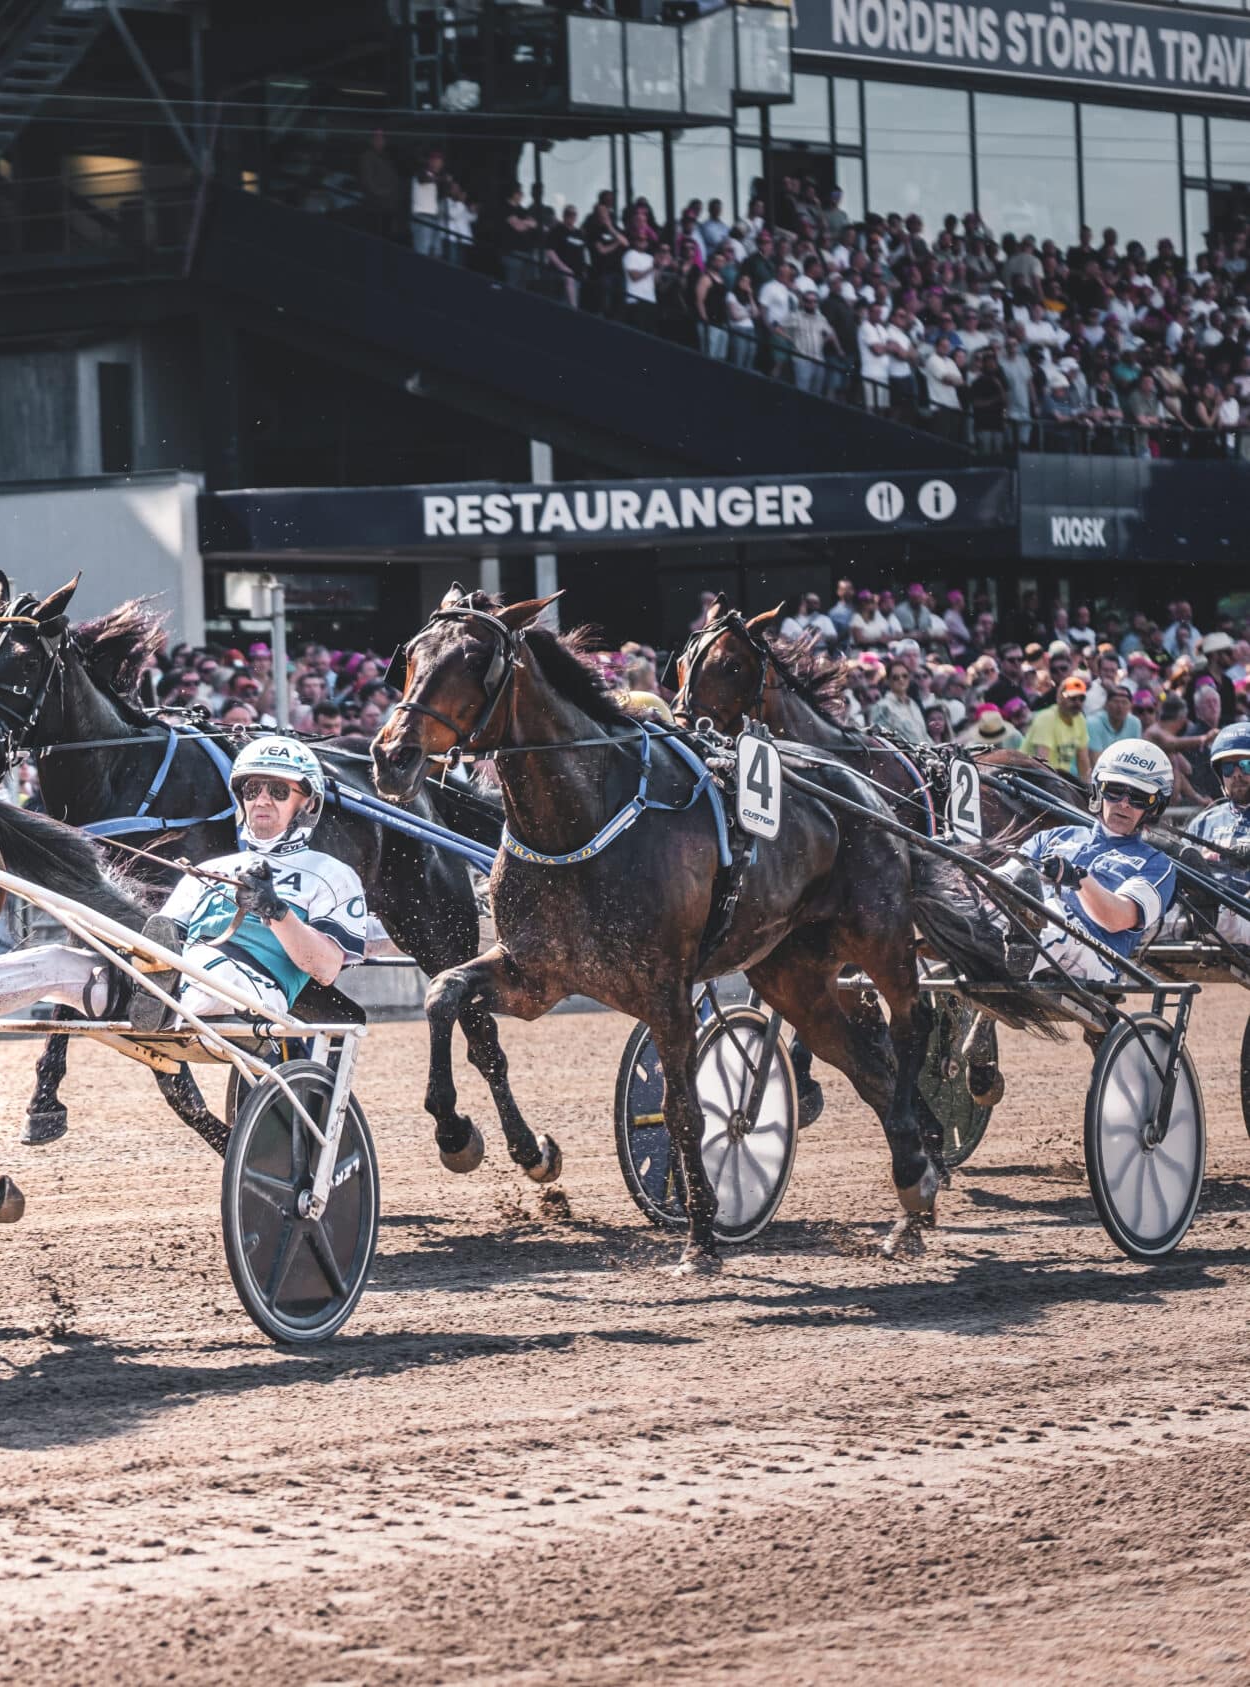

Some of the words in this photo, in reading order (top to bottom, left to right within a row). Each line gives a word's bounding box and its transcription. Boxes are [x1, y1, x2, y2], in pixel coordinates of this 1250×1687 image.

[831, 0, 1001, 61] NORDENS
[1005, 3, 1155, 78] STÖRSTA
[424, 485, 813, 536] RESTAURANGER
[1051, 516, 1106, 547] KIOSK
[747, 743, 773, 810] 4
[957, 764, 973, 823] 2
[742, 809, 775, 826] CUSTOM
